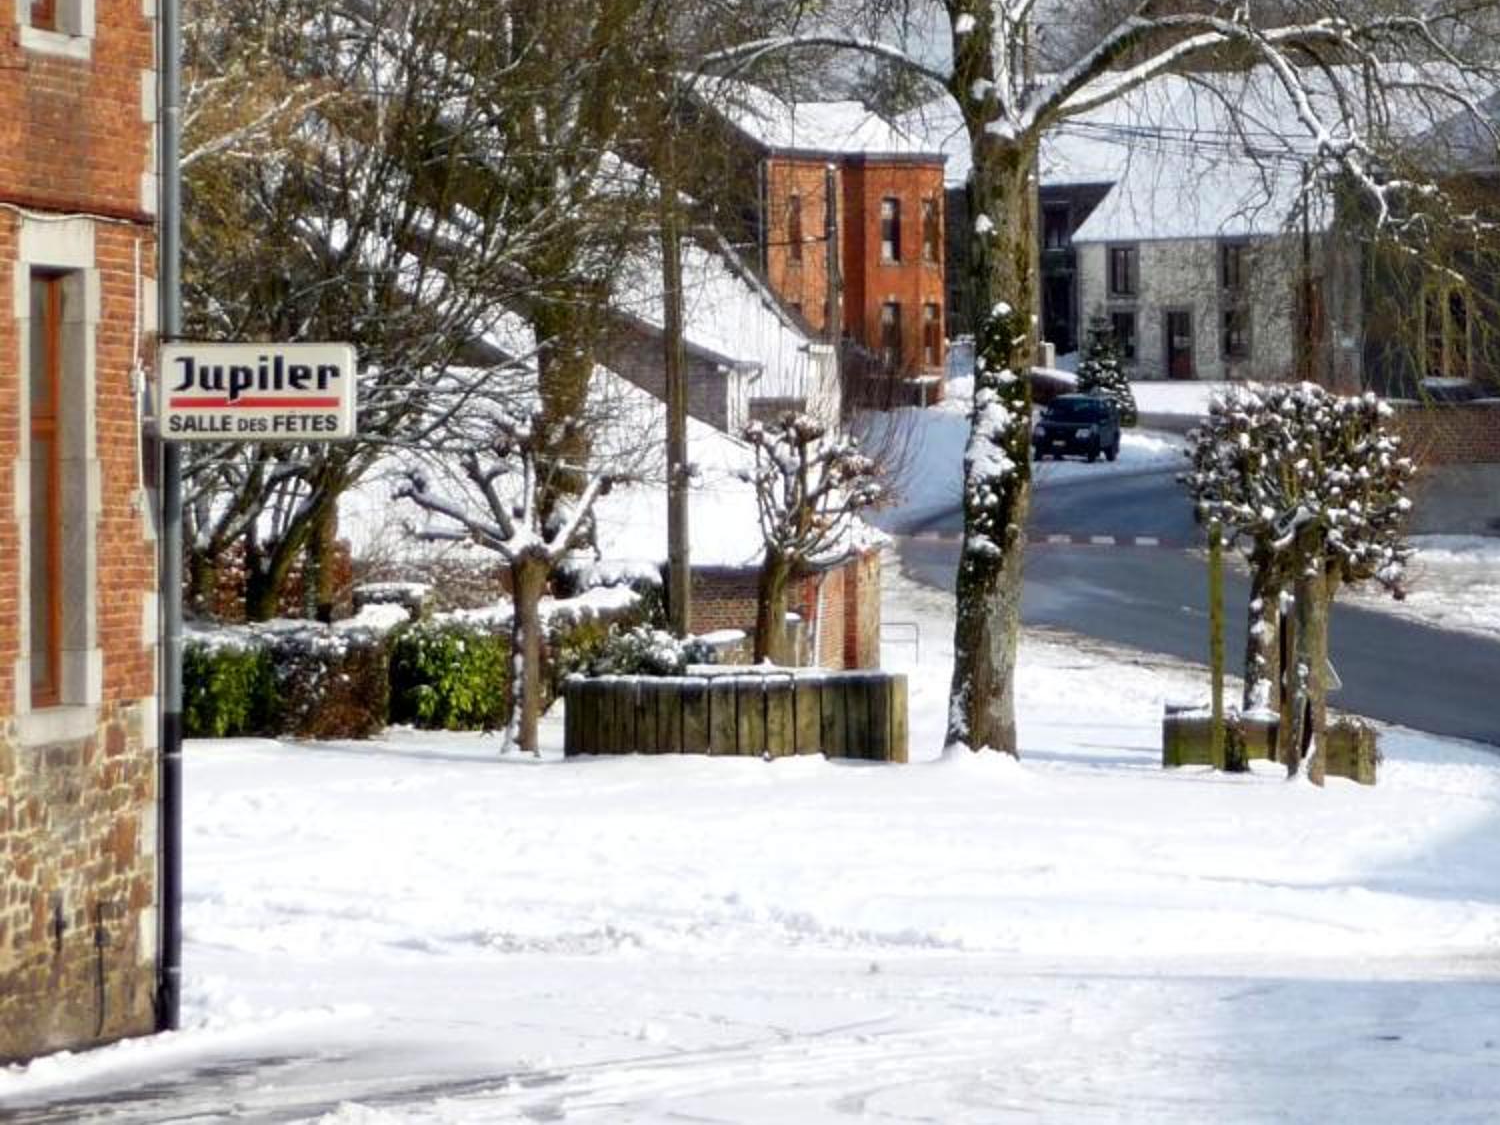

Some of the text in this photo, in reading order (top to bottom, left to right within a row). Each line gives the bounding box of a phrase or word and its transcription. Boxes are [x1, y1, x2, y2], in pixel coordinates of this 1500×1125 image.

[172, 355, 340, 401] Jupiler
[169, 414, 232, 432] SALLE
[237, 418, 267, 432] DES
